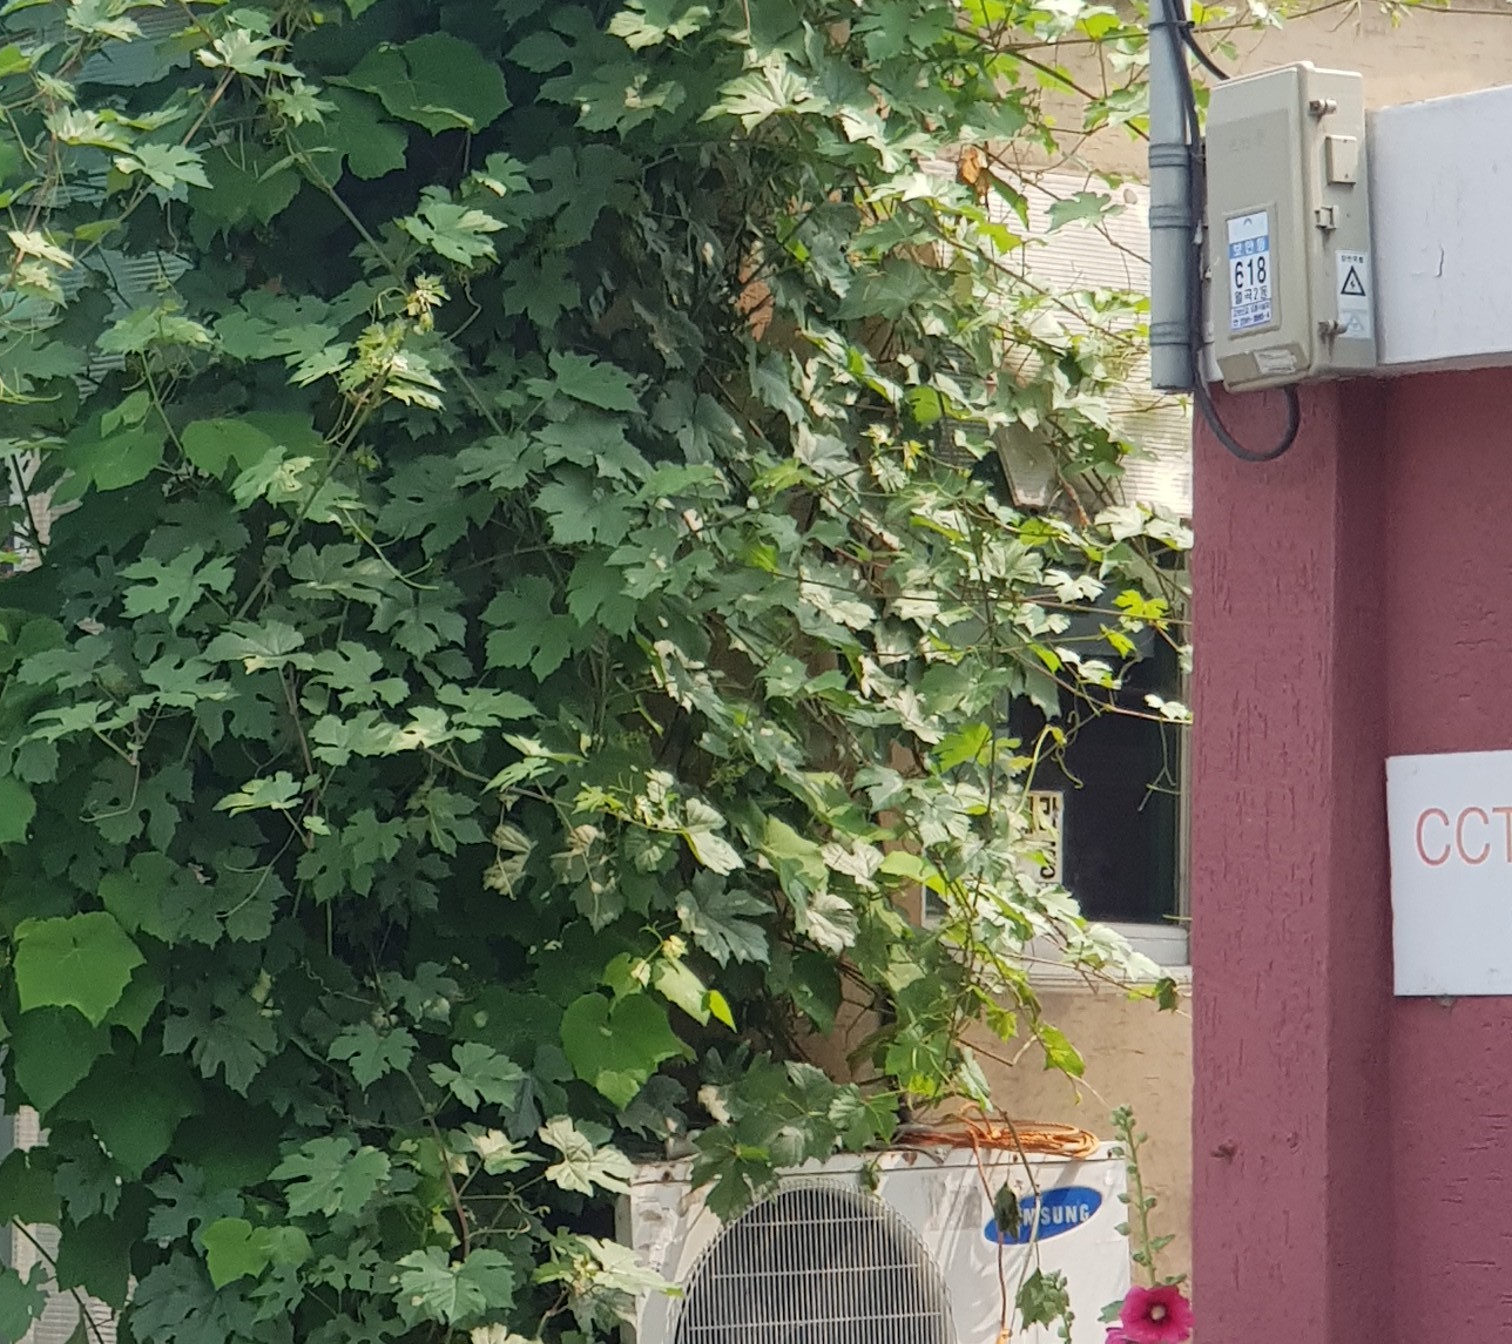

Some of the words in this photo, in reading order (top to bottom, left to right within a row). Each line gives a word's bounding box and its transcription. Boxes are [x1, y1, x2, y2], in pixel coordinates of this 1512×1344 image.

[1234, 256, 1267, 288] 618
[1416, 807, 1512, 866] CCT
[1018, 1203, 1090, 1227] MSUNG
